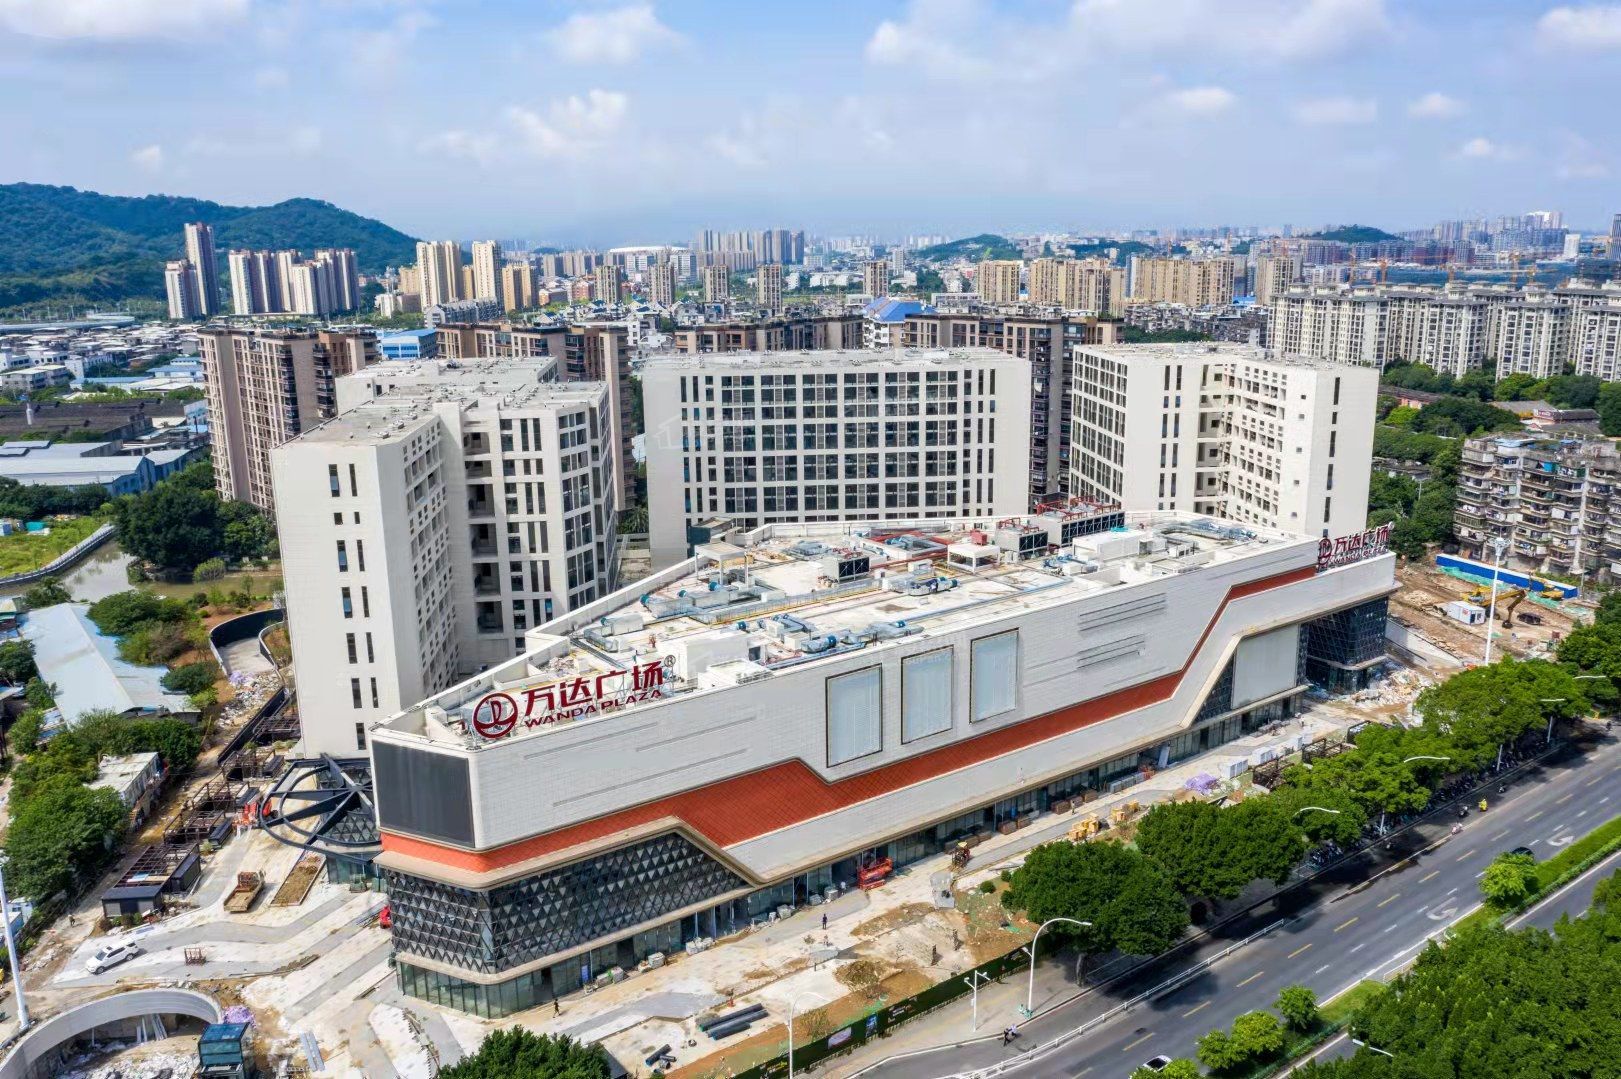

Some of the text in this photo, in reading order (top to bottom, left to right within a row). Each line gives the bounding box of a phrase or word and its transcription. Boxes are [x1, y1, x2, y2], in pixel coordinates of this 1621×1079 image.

[1334, 525, 1389, 554] 万达广场
[521, 661, 664, 717] 万达广场
[524, 689, 662, 728] WANDA PLAZA
